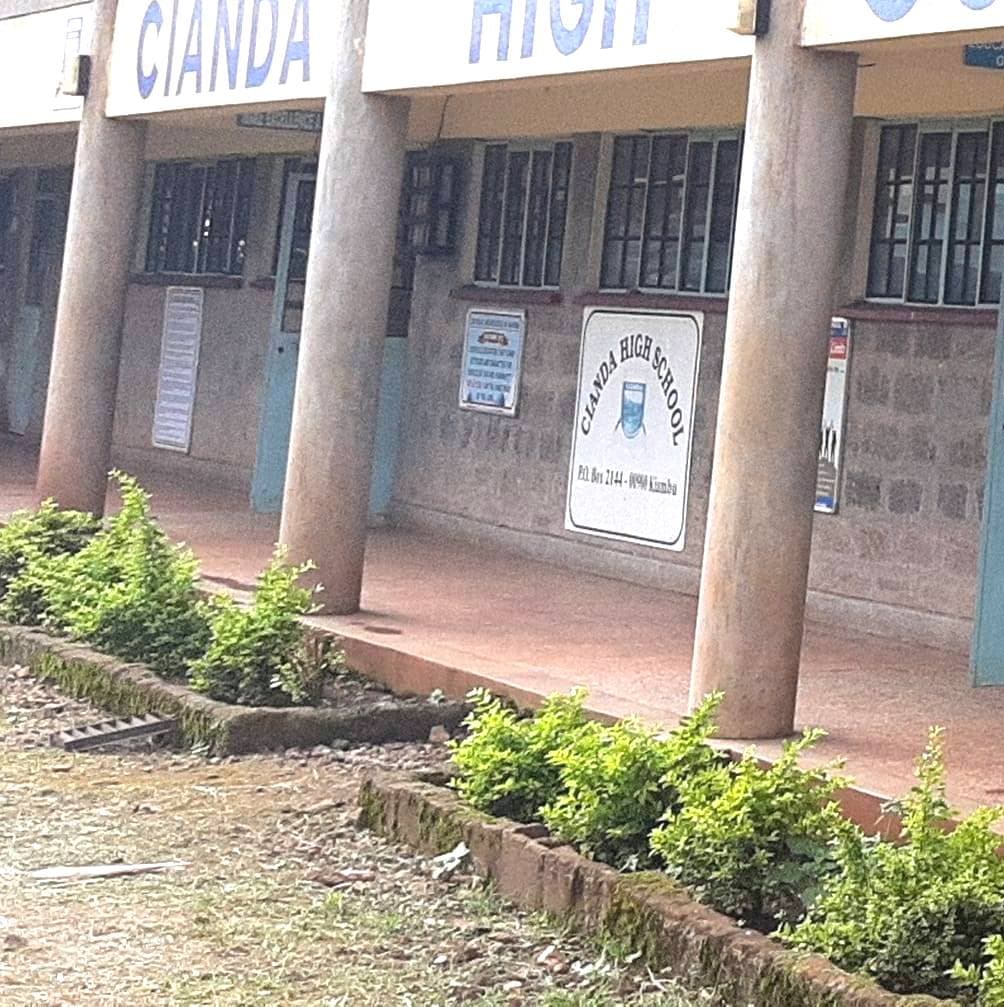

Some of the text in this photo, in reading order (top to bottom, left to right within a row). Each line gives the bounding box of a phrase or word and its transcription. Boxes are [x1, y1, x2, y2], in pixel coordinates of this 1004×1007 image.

[581, 333, 685, 446] CIANDA HIGH SCHOOL
